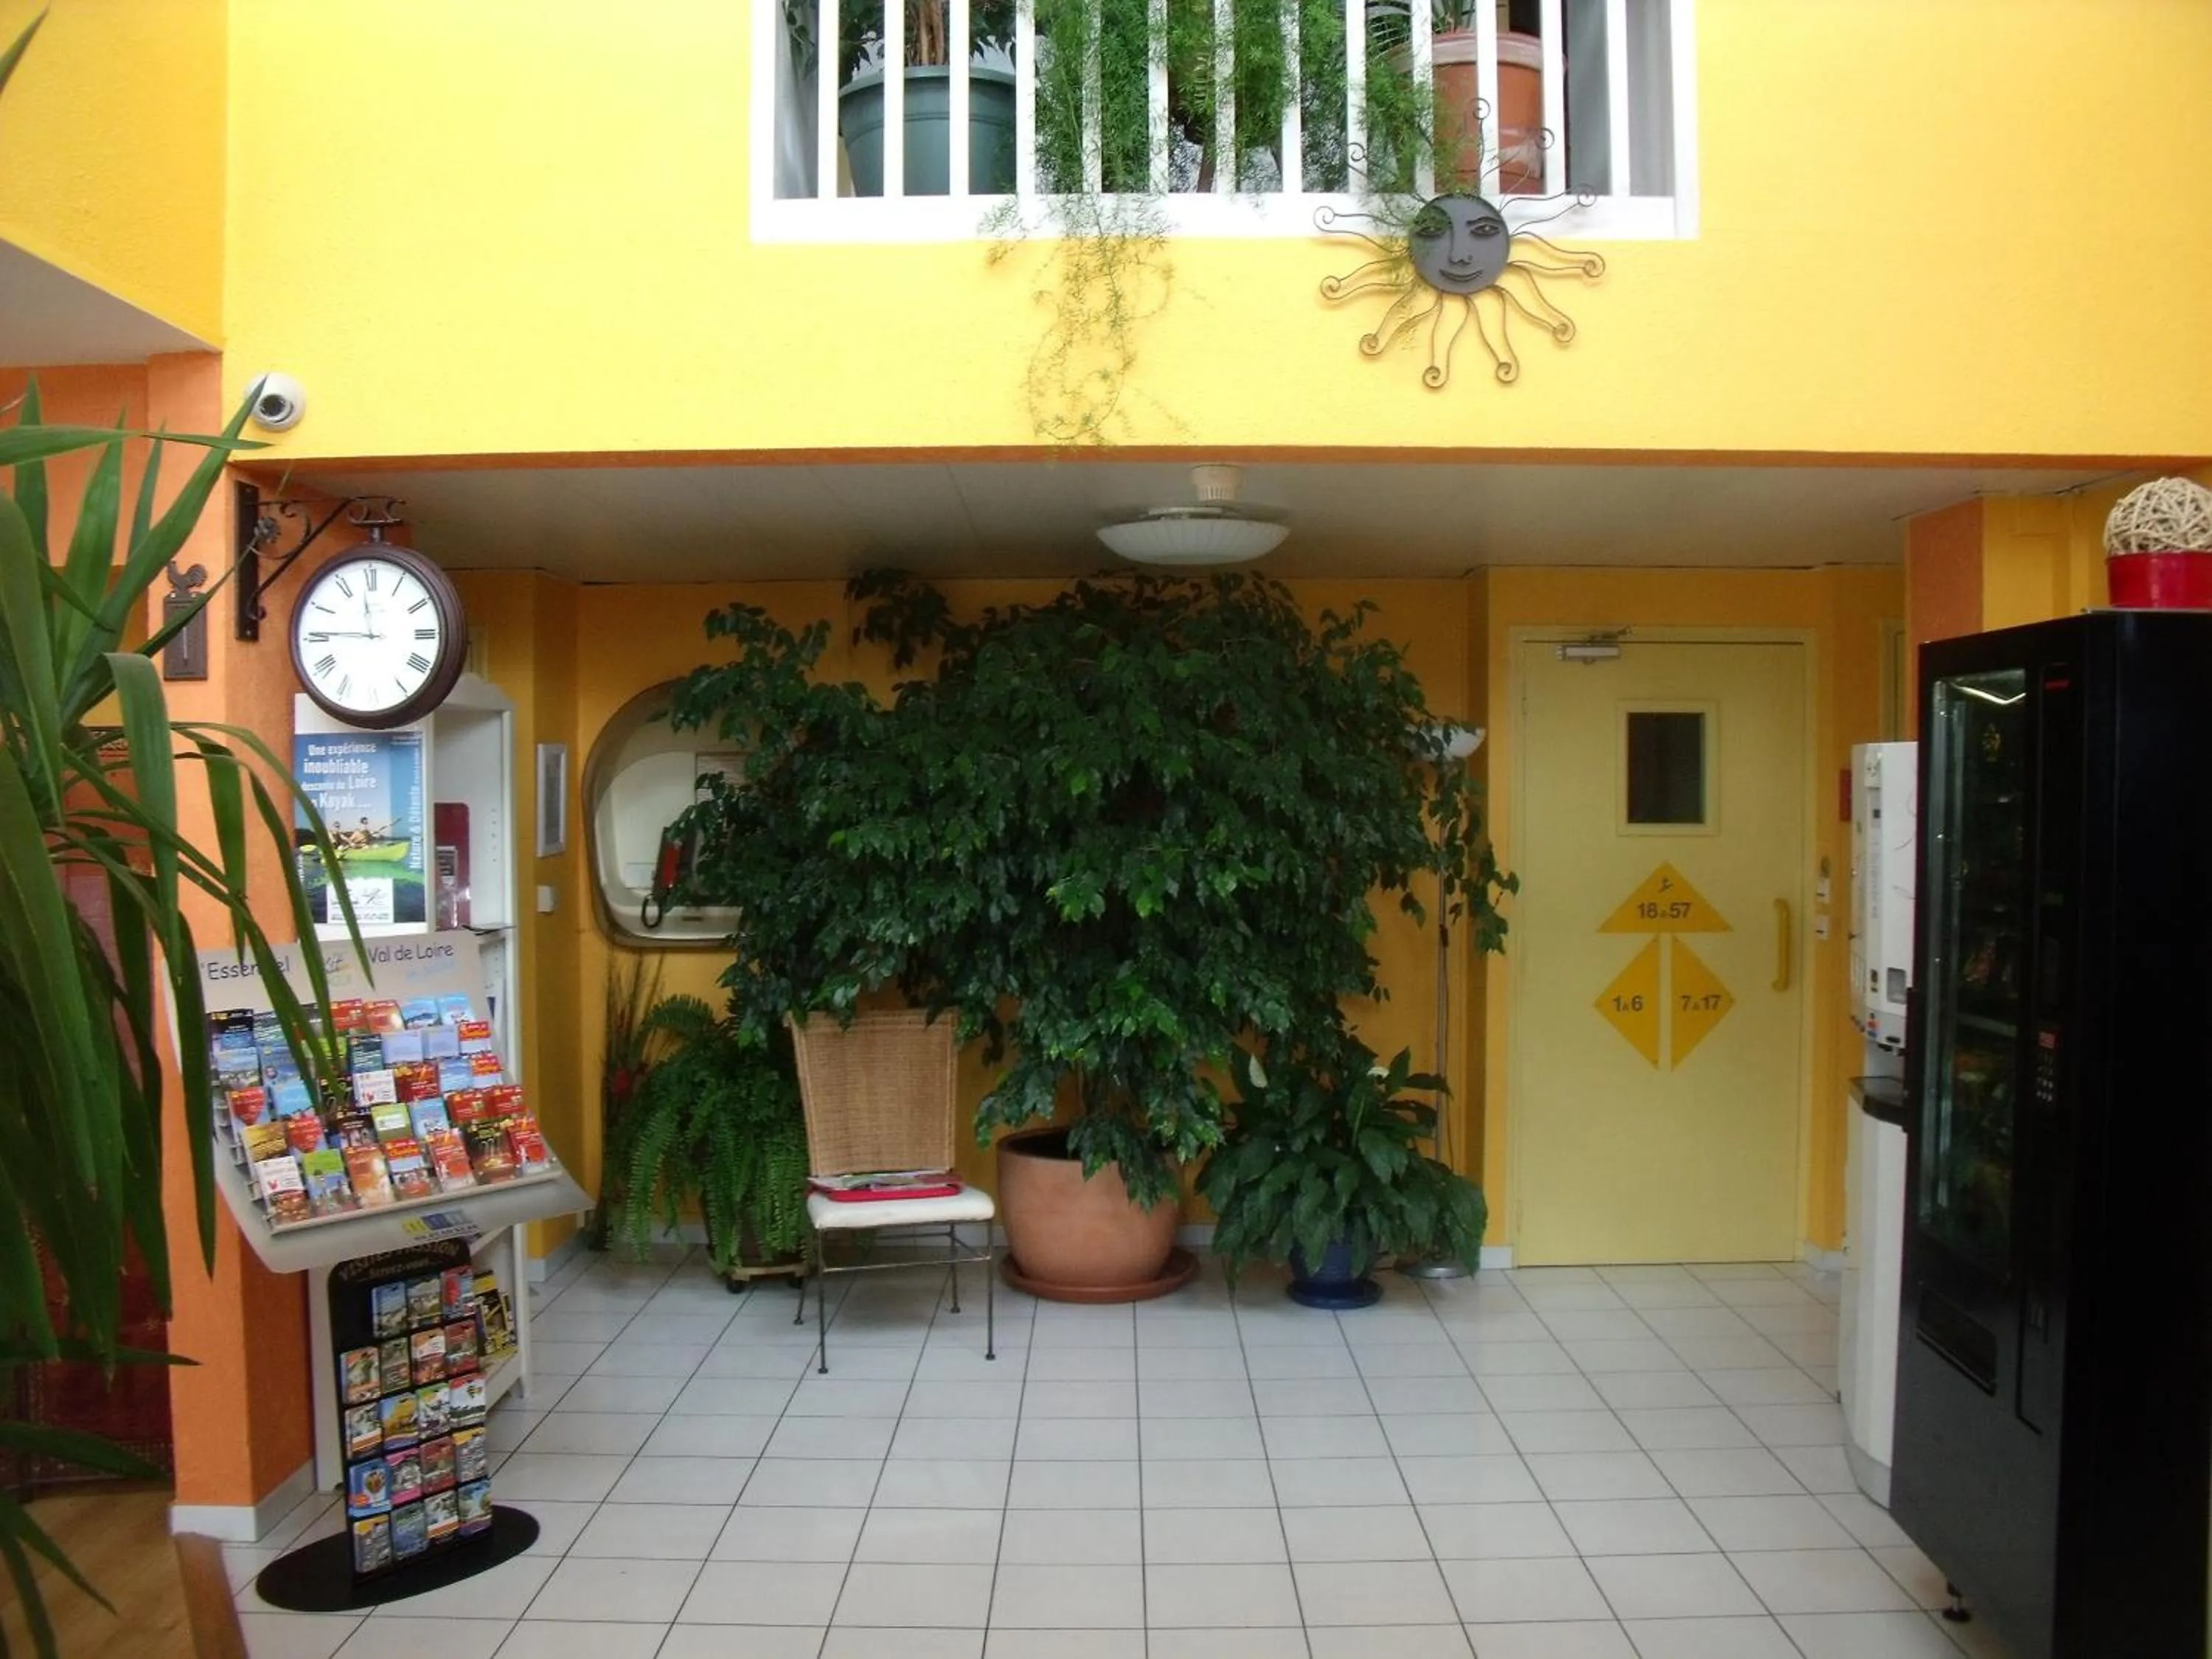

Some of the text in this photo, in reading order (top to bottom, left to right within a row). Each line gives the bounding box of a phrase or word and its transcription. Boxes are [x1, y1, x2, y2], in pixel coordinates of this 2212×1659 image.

[303, 758, 369, 774] inoubliable
[1637, 902, 1658, 919] 18
[1669, 902, 1692, 919] 57
[394, 945, 414, 961] de
[417, 942, 454, 959] Loire
[1631, 995, 1644, 1012] 6
[1680, 995, 1691, 1012] 7
[1701, 994, 1722, 1011] 17
